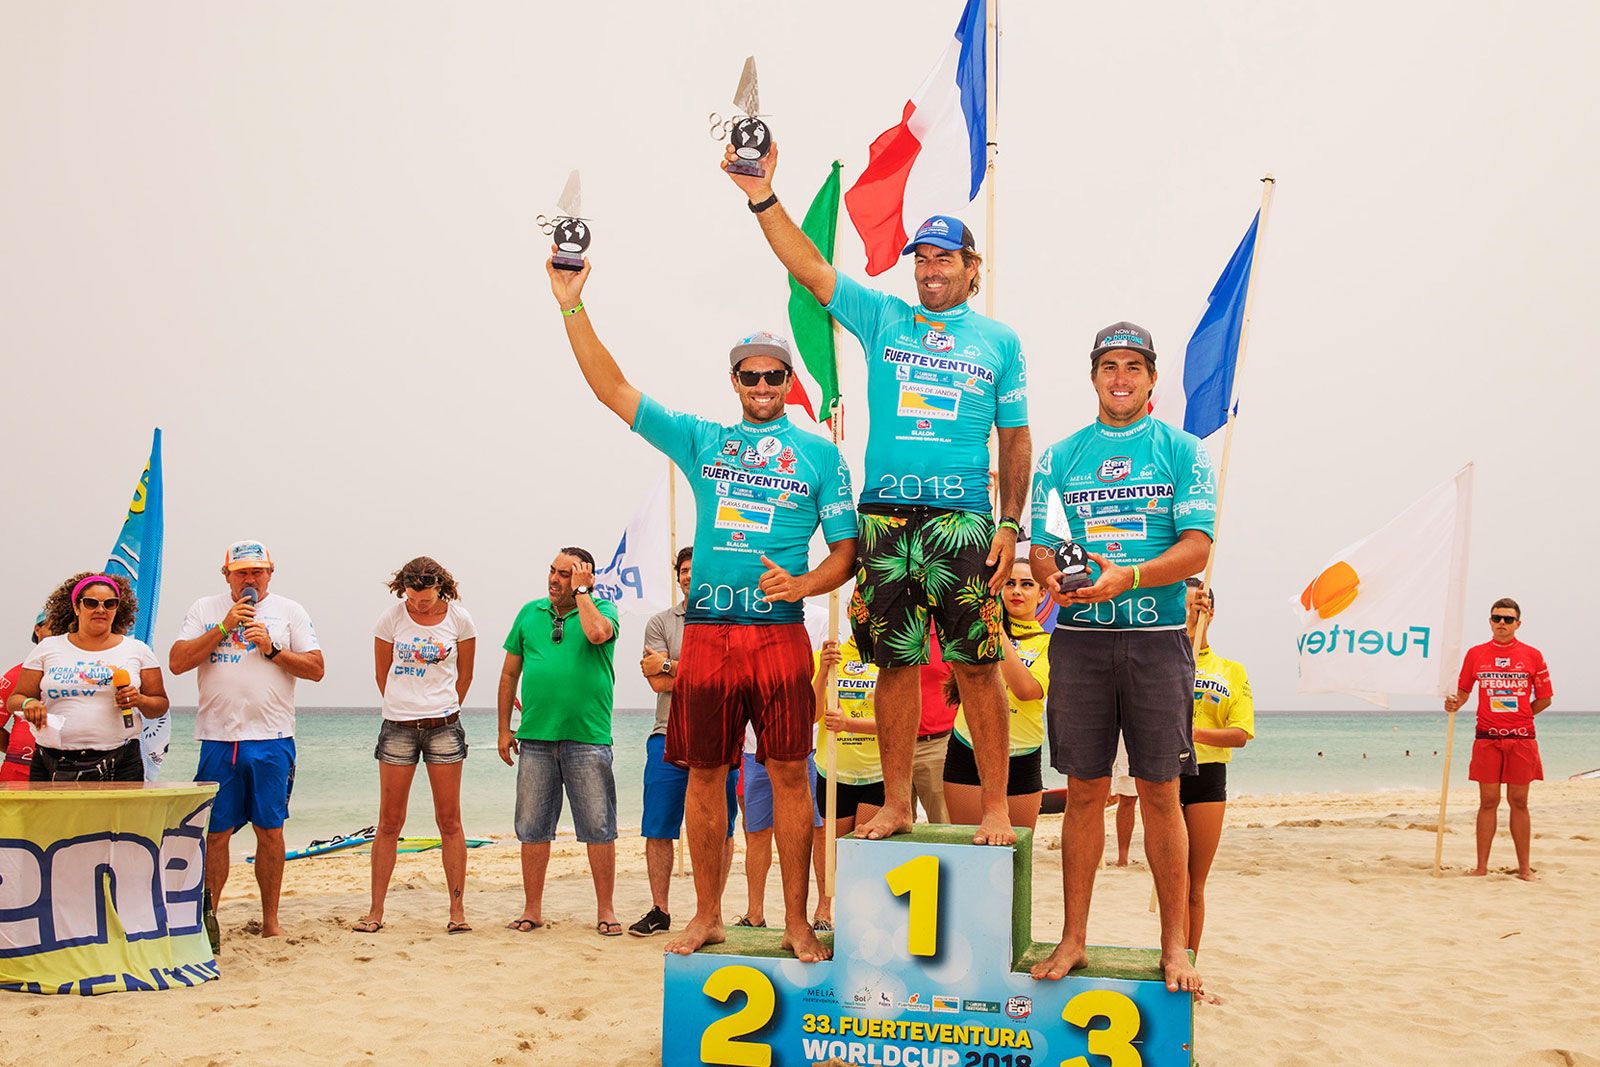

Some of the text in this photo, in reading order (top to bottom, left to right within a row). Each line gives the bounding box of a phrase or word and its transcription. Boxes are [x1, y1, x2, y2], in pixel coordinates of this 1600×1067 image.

[884, 347, 995, 384] FUERTEVENTURA
[901, 384, 925, 394] PLAYAS
[1101, 422, 1147, 438] FUERTEVENTURA
[702, 464, 810, 497] FUERTEVENTURA
[878, 473, 965, 500] 2018
[1063, 484, 1174, 506] UERTEVENTURA
[720, 500, 742, 510] PLAYAS
[695, 583, 773, 613] 2018
[1072, 596, 1159, 625] 2018
[398, 651, 412, 660] CUP
[421, 645, 440, 654] WIND
[210, 652, 242, 664] CREW
[49, 666, 80, 675] WORLD
[53, 673, 75, 681] CUP
[394, 665, 426, 678] CREW
[47, 688, 97, 700] CREW
[885, 854, 940, 956] 1
[854, 994, 866, 1002] Sol
[1008, 997, 1032, 1007] René
[700, 965, 776, 1067] 2
[1008, 1004, 1032, 1016] Egli
[802, 1013, 1032, 1049] 33. FUERTEVENTURA
[1060, 990, 1143, 1067] 3
[802, 1038, 1032, 1067] WORLDCUP 2018
